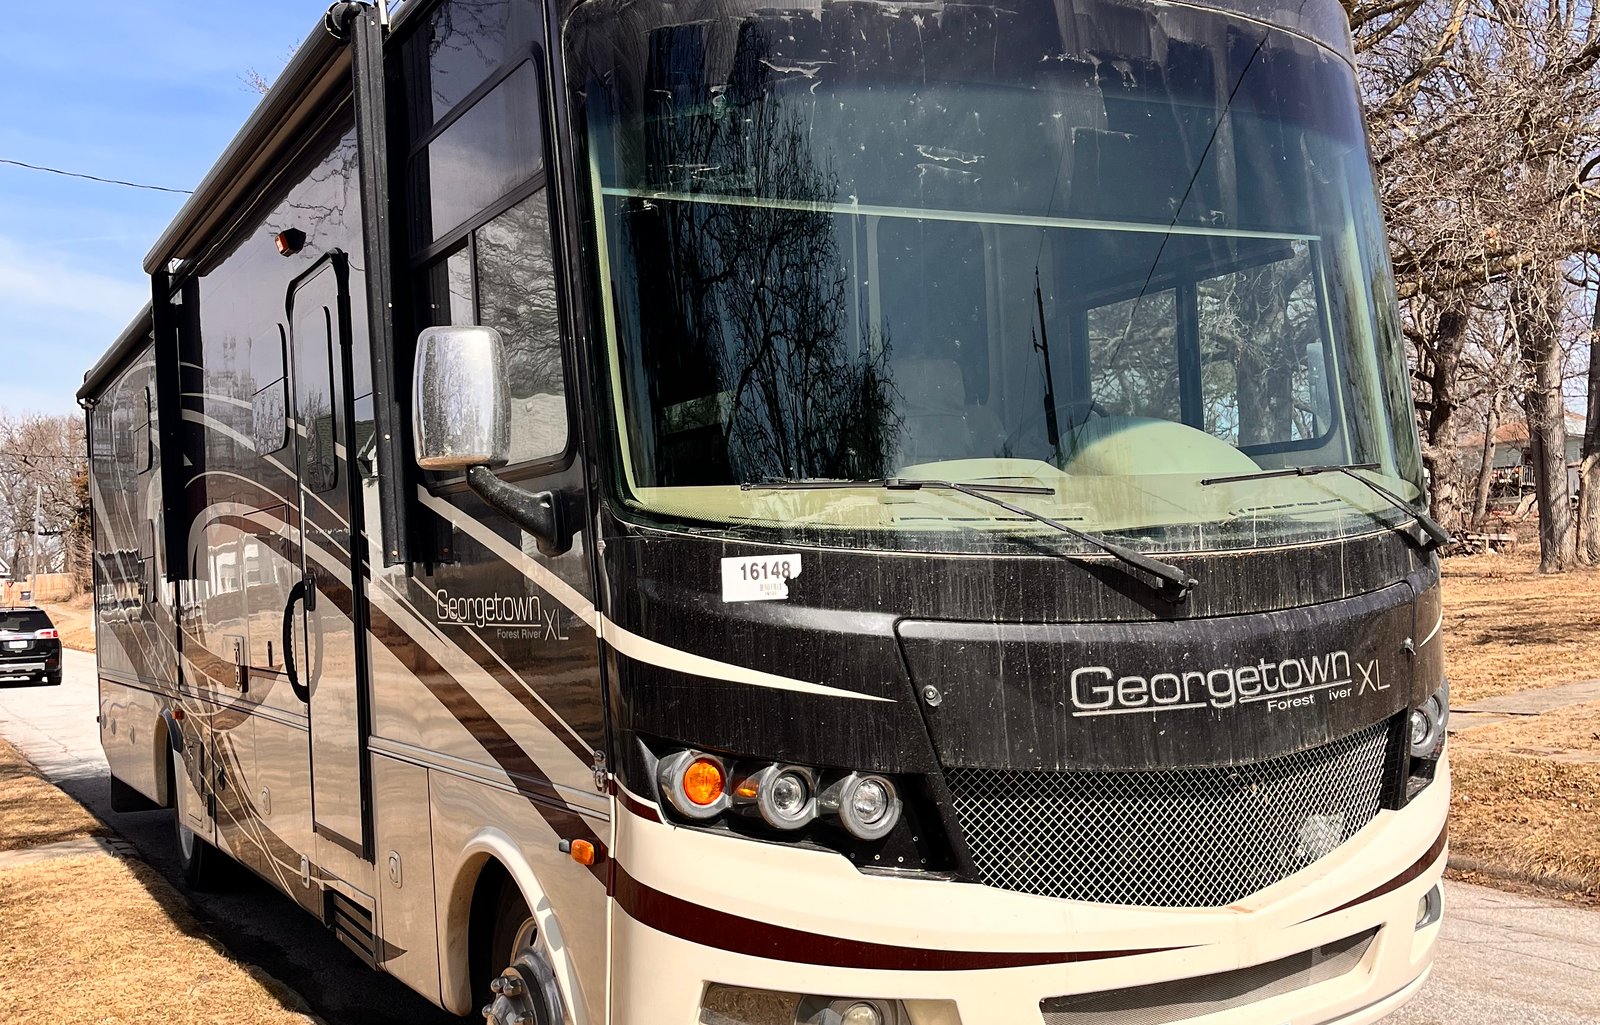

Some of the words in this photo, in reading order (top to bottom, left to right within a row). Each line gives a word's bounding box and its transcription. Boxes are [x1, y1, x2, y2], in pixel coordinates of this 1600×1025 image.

[740, 561, 791, 580] 16148
[436, 589, 541, 628] Georgetown
[543, 609, 569, 641] XL
[497, 629, 519, 639] Forest
[522, 629, 541, 639] River
[1070, 650, 1351, 708] Georgetown
[1356, 659, 1390, 696] XL
[1267, 694, 1315, 712] Forest
